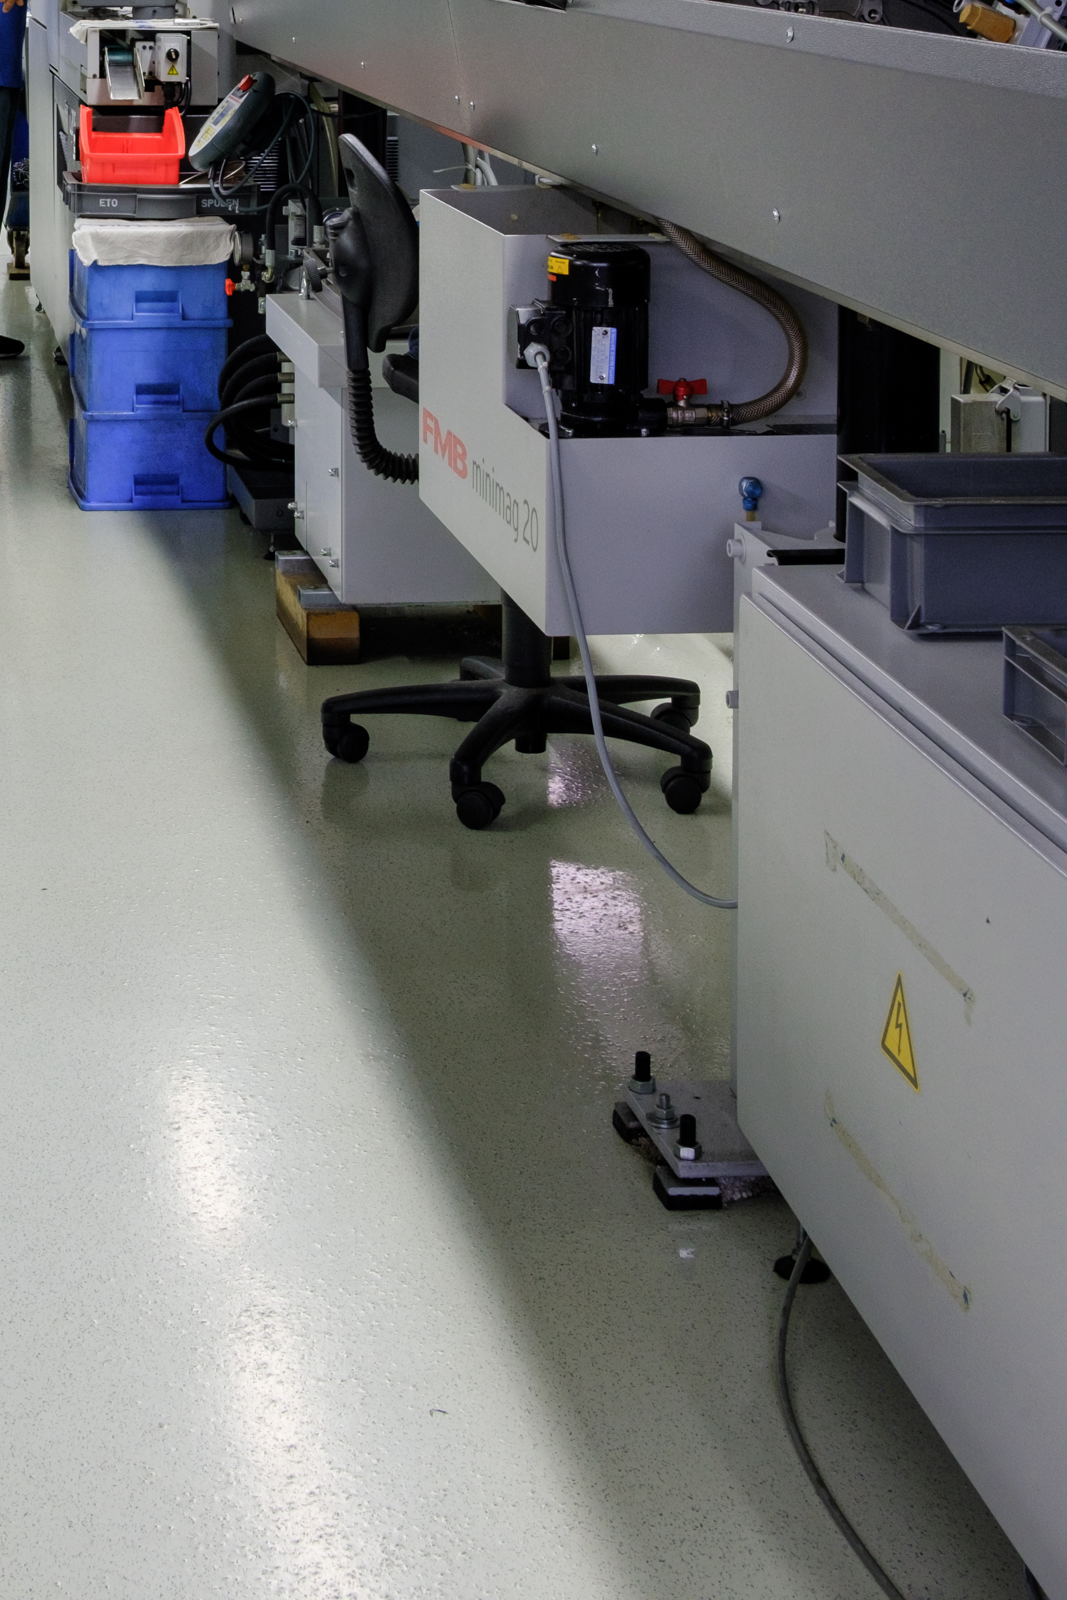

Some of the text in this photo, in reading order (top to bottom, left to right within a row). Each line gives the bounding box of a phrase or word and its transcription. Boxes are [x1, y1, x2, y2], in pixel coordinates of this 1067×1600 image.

[99, 199, 118, 208] ETO
[422, 406, 539, 553] FMB minimag 20
